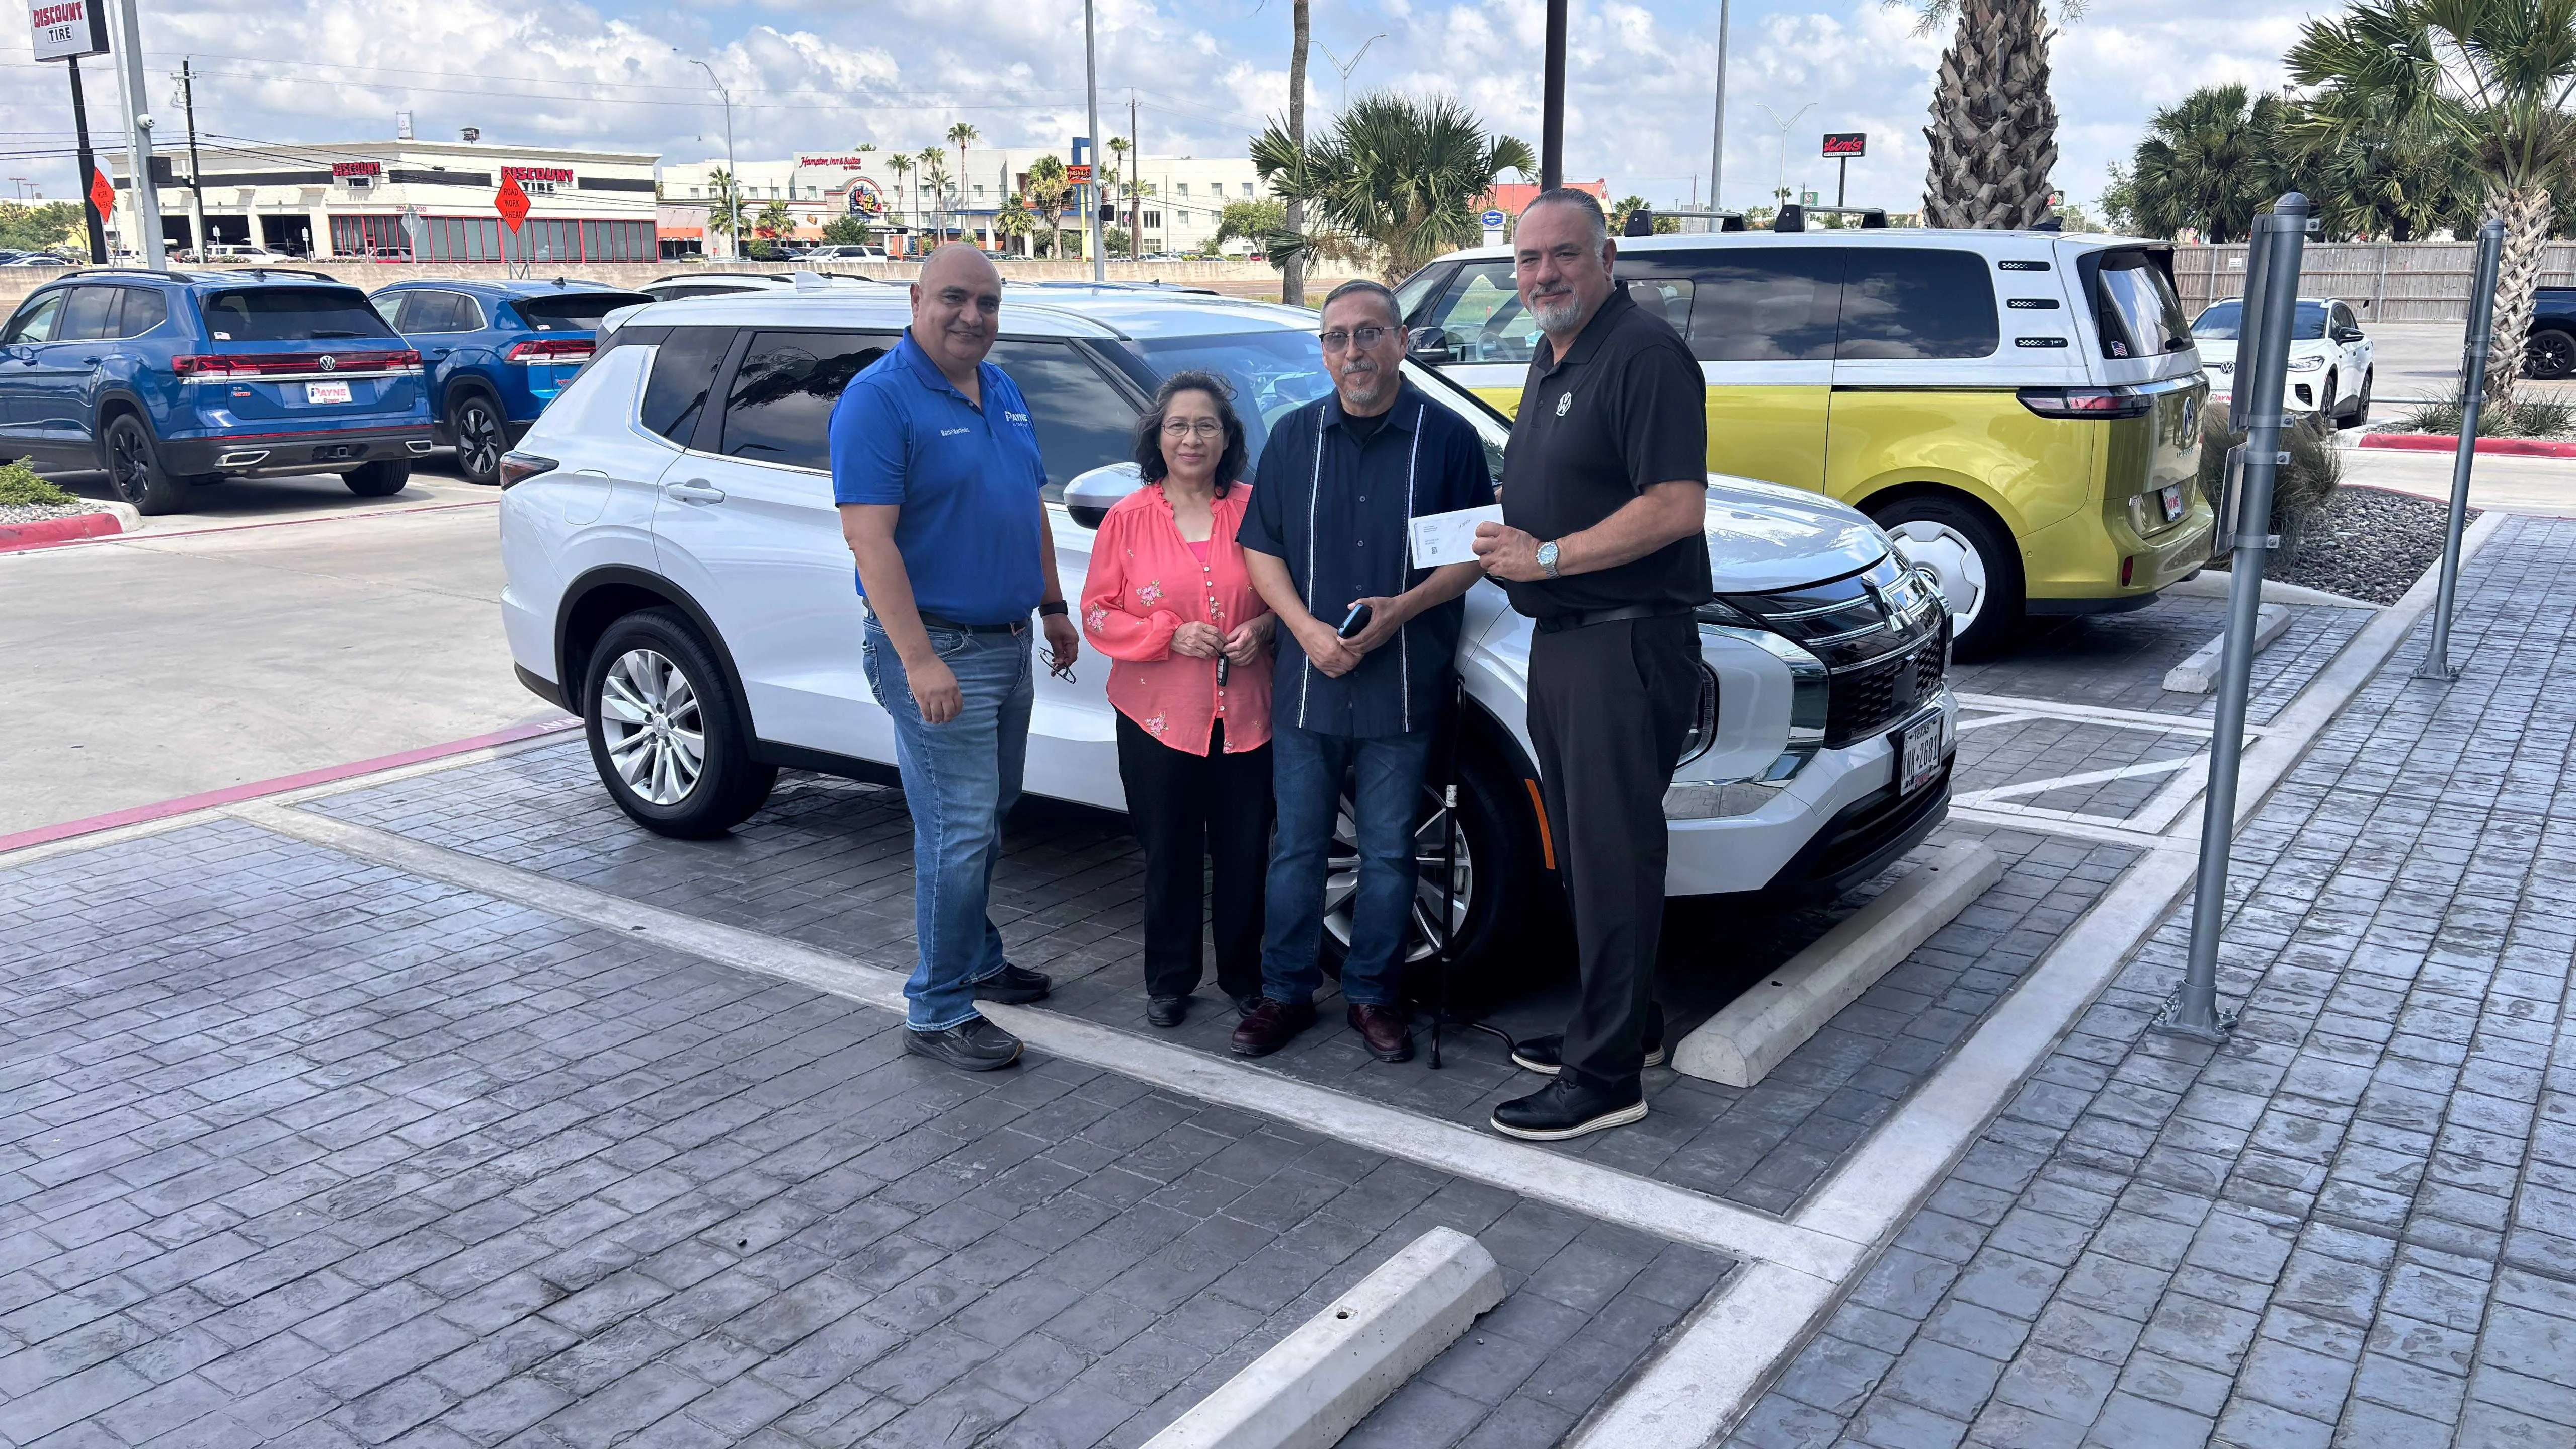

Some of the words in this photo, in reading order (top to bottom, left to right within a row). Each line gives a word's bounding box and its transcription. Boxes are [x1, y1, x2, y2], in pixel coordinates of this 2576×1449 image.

[33, 1, 83, 28] DISCOUNT
[49, 27, 71, 41] TIRE
[799, 156, 829, 168] Hampton
[332, 162, 381, 176] DISCOUNT
[501, 166, 573, 182] DISCOUNT
[503, 188, 518, 196] ROAD
[522, 182, 554, 191] TIRE
[505, 211, 523, 219] AHEAD
[1004, 411, 1028, 422] PAYNE
[1914, 726, 1929, 741] TEXAS
